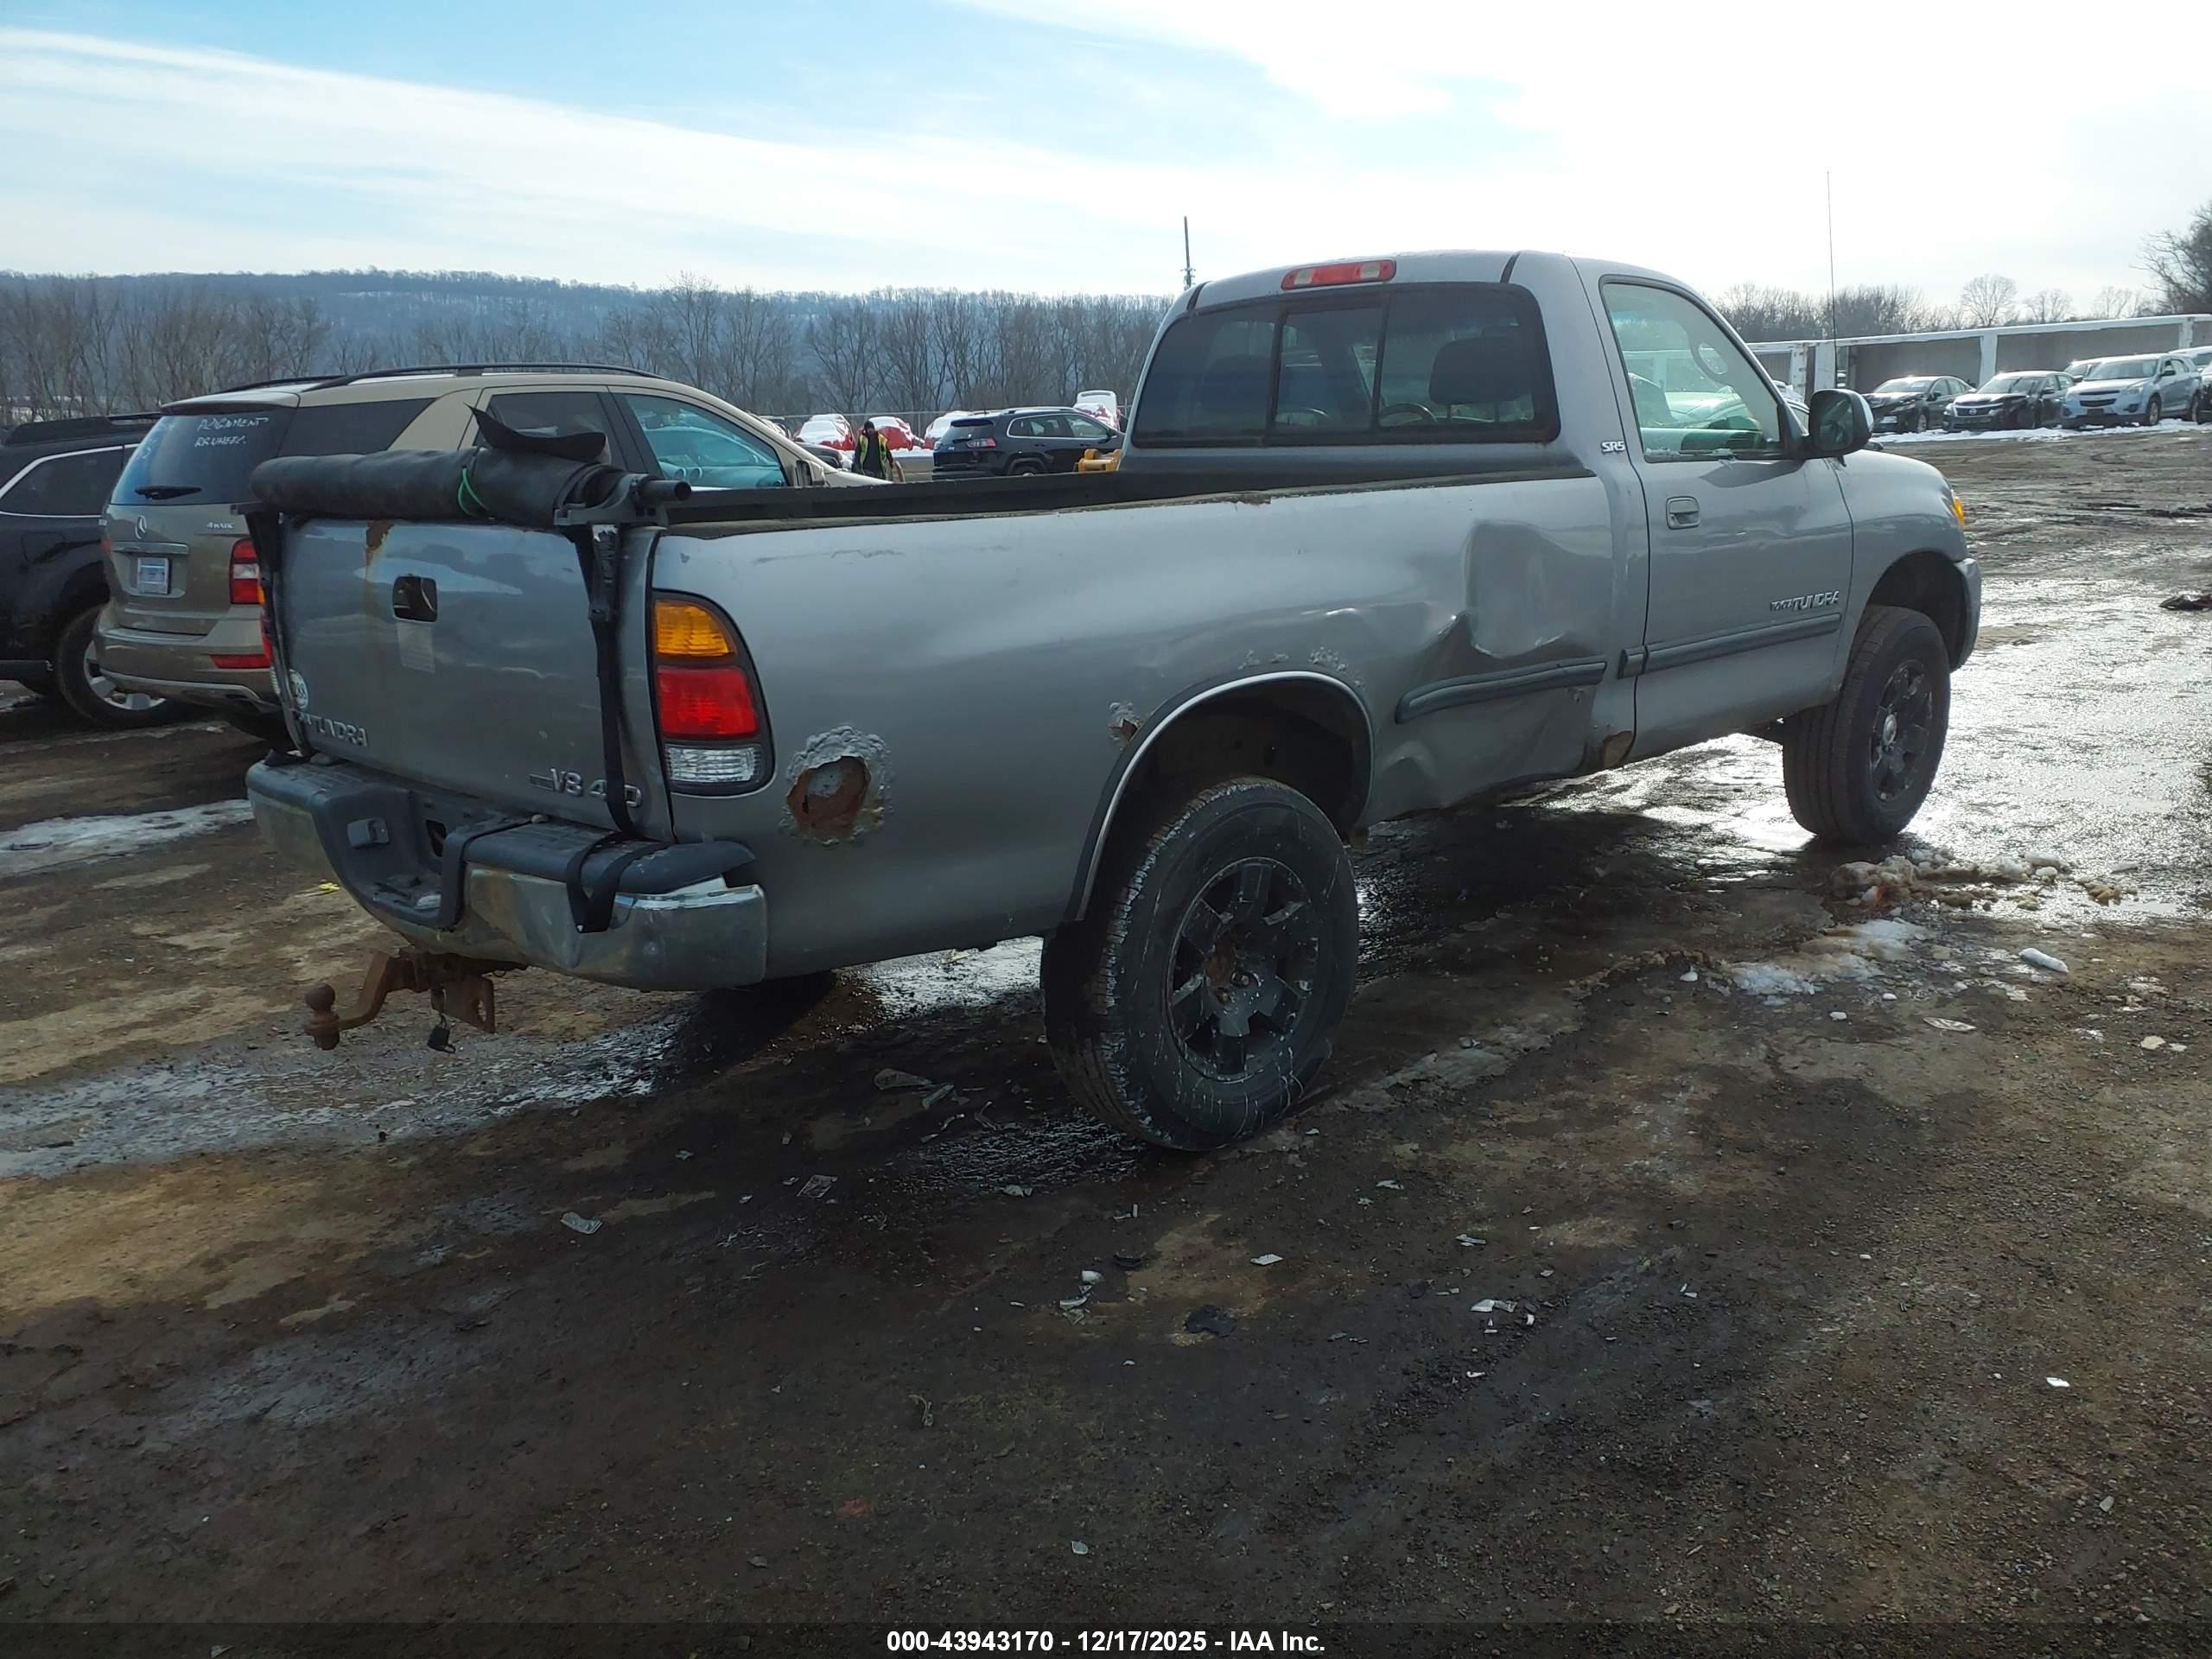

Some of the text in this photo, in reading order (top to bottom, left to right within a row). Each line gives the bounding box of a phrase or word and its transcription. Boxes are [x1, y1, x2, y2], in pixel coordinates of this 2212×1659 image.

[1601, 441, 1625, 453] SR5
[550, 767, 582, 796] V8
[589, 779, 642, 808] 4D
